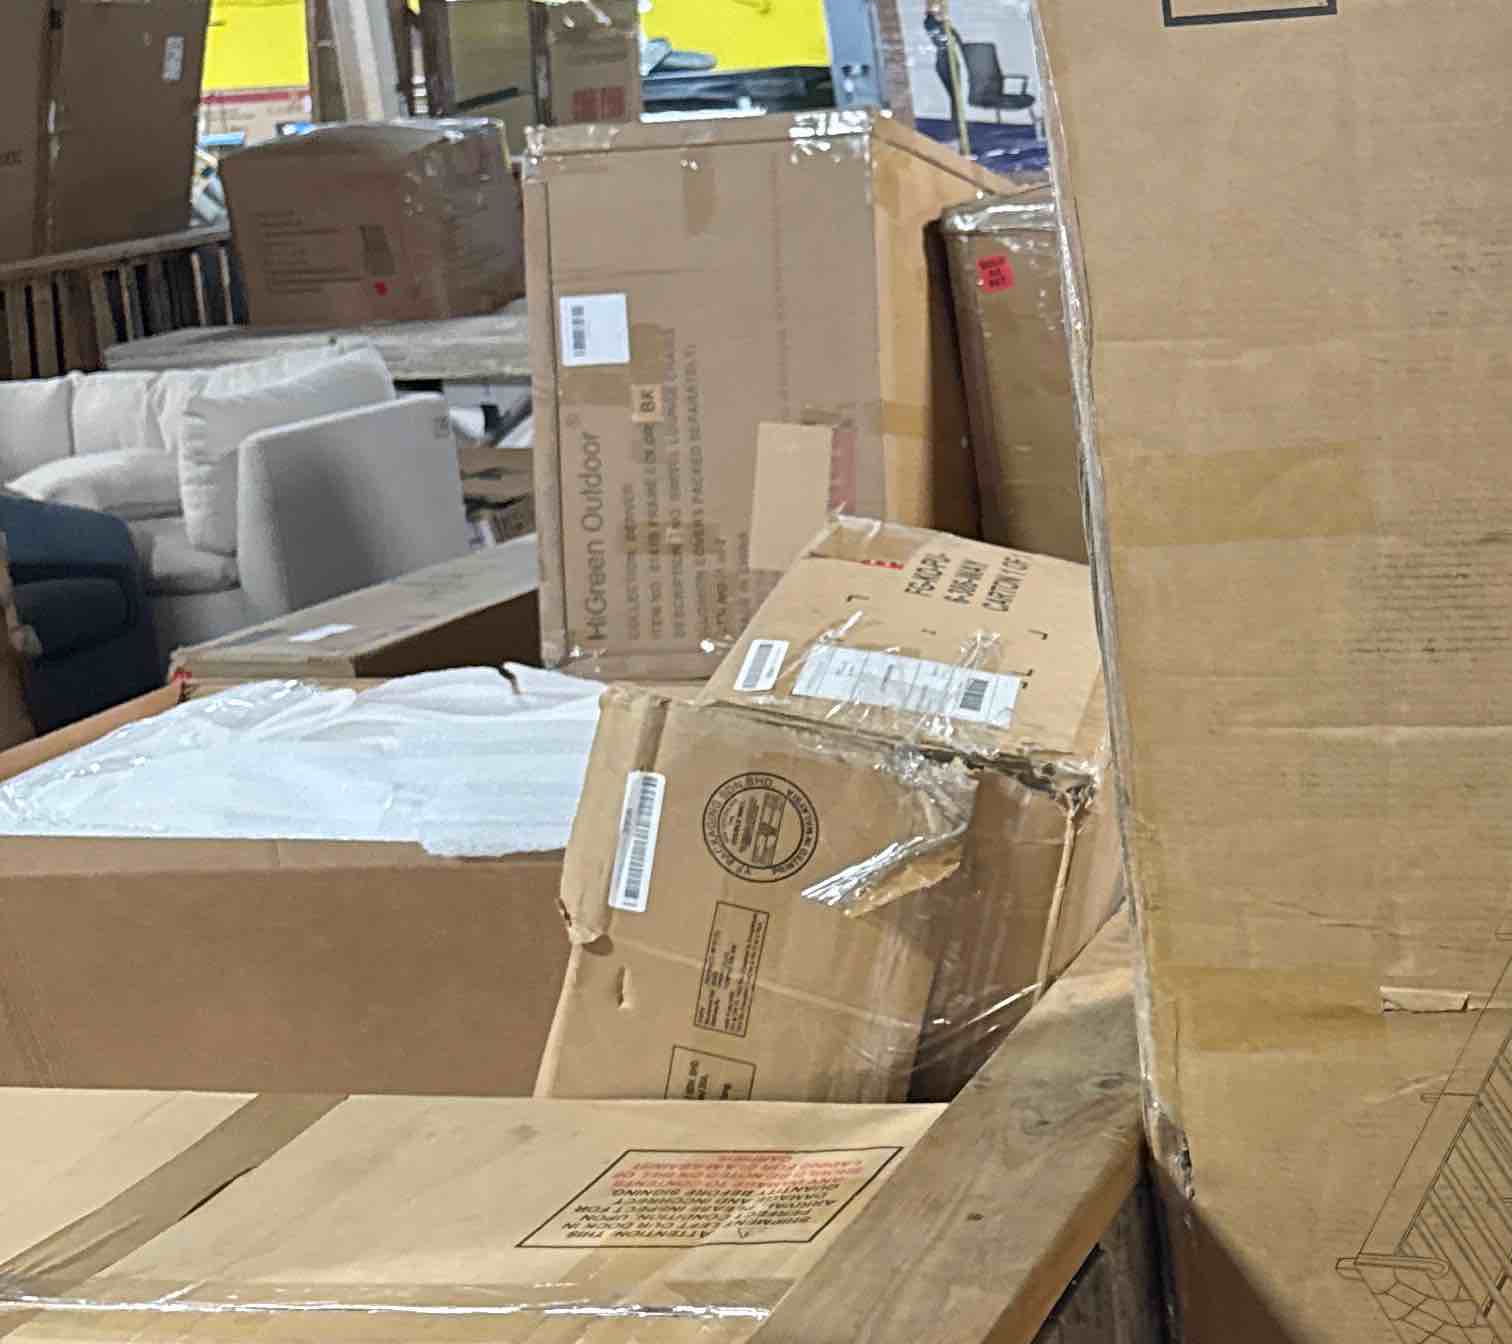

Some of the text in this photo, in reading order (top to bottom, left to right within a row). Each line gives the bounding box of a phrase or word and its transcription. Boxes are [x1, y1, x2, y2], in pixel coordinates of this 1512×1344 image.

[640, 390, 655, 413] BK
[577, 432, 608, 640] HiGreen Outdoor
